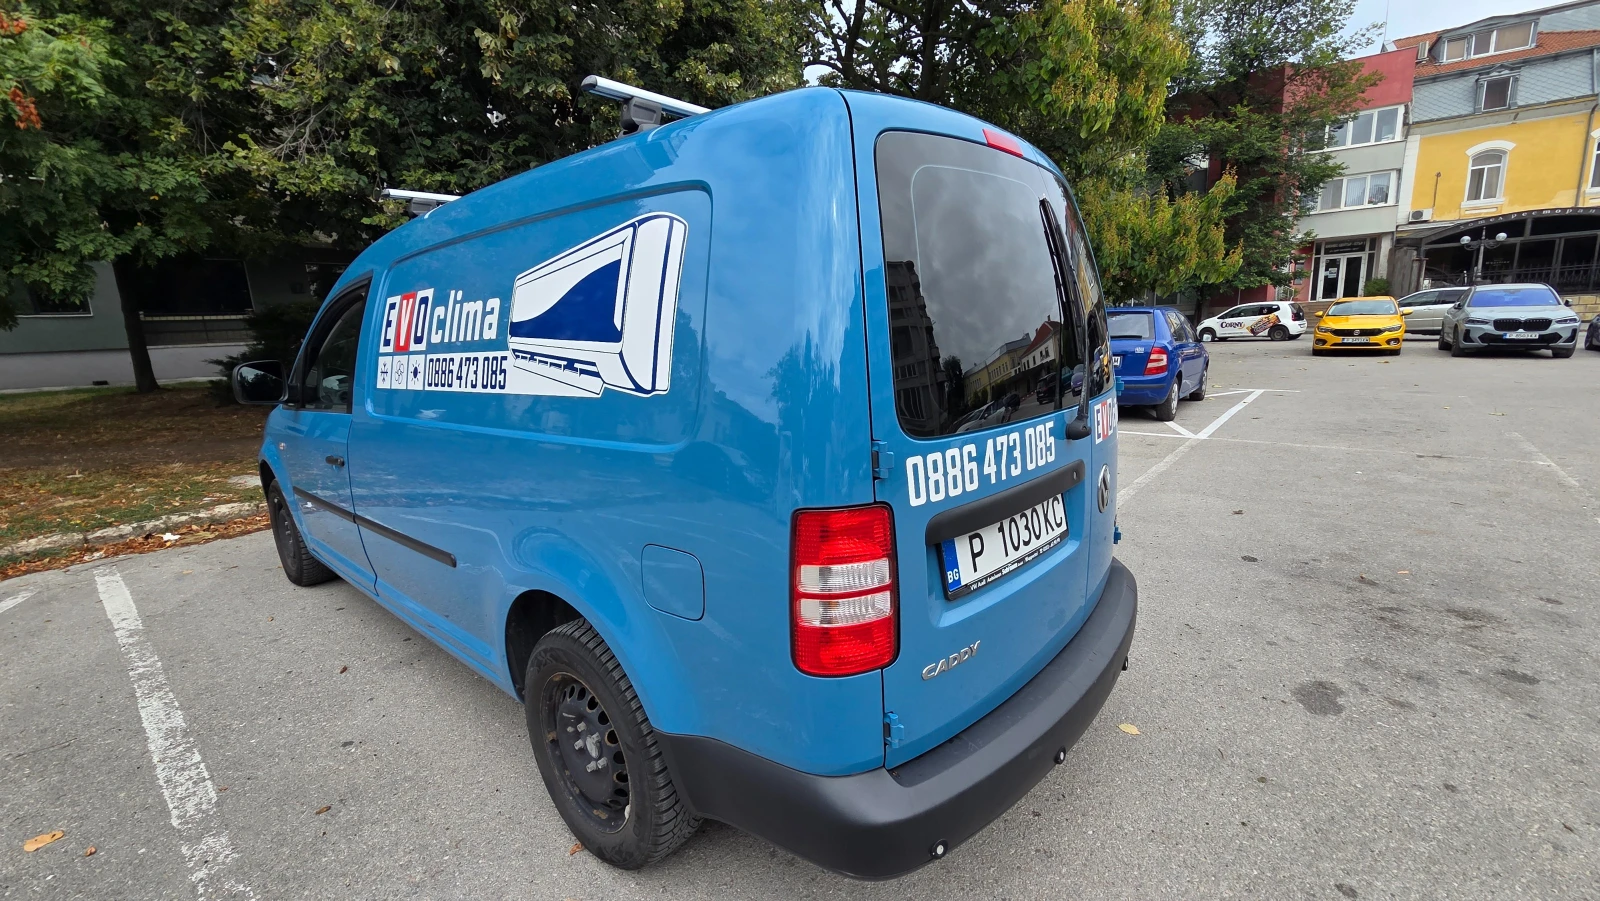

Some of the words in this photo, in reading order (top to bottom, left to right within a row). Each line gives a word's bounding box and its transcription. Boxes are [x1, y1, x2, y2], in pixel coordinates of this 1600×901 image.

[427, 357, 455, 388] 0886
[456, 356, 479, 389] 473
[481, 355, 508, 390] 085
[905, 443, 979, 507] 0886
[983, 431, 1022, 484] 473
[1025, 420, 1056, 470] 085
[946, 568, 960, 584] BG
[968, 531, 985, 574] P
[921, 640, 981, 680] CADDY
